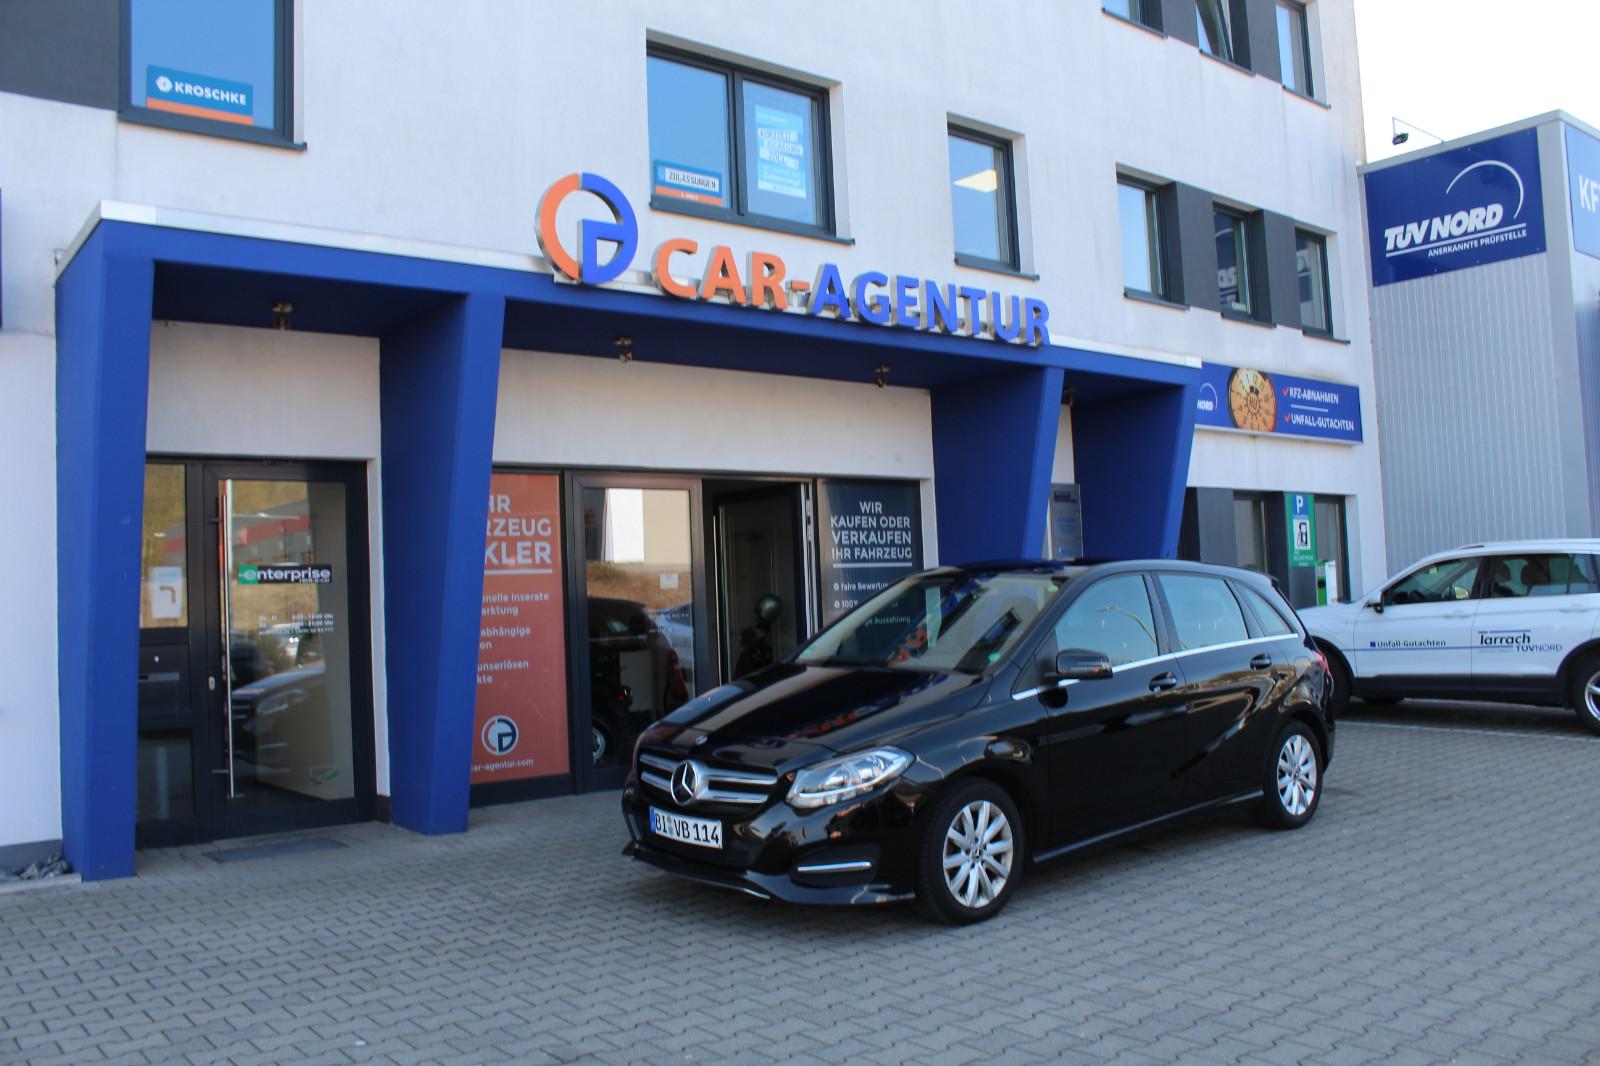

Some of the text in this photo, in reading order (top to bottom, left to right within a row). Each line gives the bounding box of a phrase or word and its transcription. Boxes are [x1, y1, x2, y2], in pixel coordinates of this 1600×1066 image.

[174, 81, 247, 106] KROSCHKE
[668, 169, 717, 190] ZULASSUNGEN
[1578, 175, 1600, 213] KF
[1430, 203, 1503, 241] NORD
[1427, 229, 1527, 258] ANERKANNTE PRÜFSTELLE
[654, 237, 1050, 346] CAR-AGENTUR
[1289, 386, 1340, 405] KFZ-ABNAHMEN
[1290, 412, 1355, 431] UNFALL-GUTACHTEN
[859, 501, 883, 514] WIR
[1295, 495, 1304, 513] P
[830, 515, 911, 529] KAUFEN ODER
[832, 530, 912, 545] VERKAUFEN
[831, 547, 912, 560] IHR FAHRZEUG
[243, 567, 331, 582] enterprise
[841, 582, 857, 591] faire
[511, 592, 550, 603] Inserate
[480, 626, 531, 638] abhängige
[1376, 639, 1447, 648] Unfall-Gutachten
[476, 673, 493, 684] kte
[673, 818, 690, 839] VB
[692, 823, 720, 845] 114
